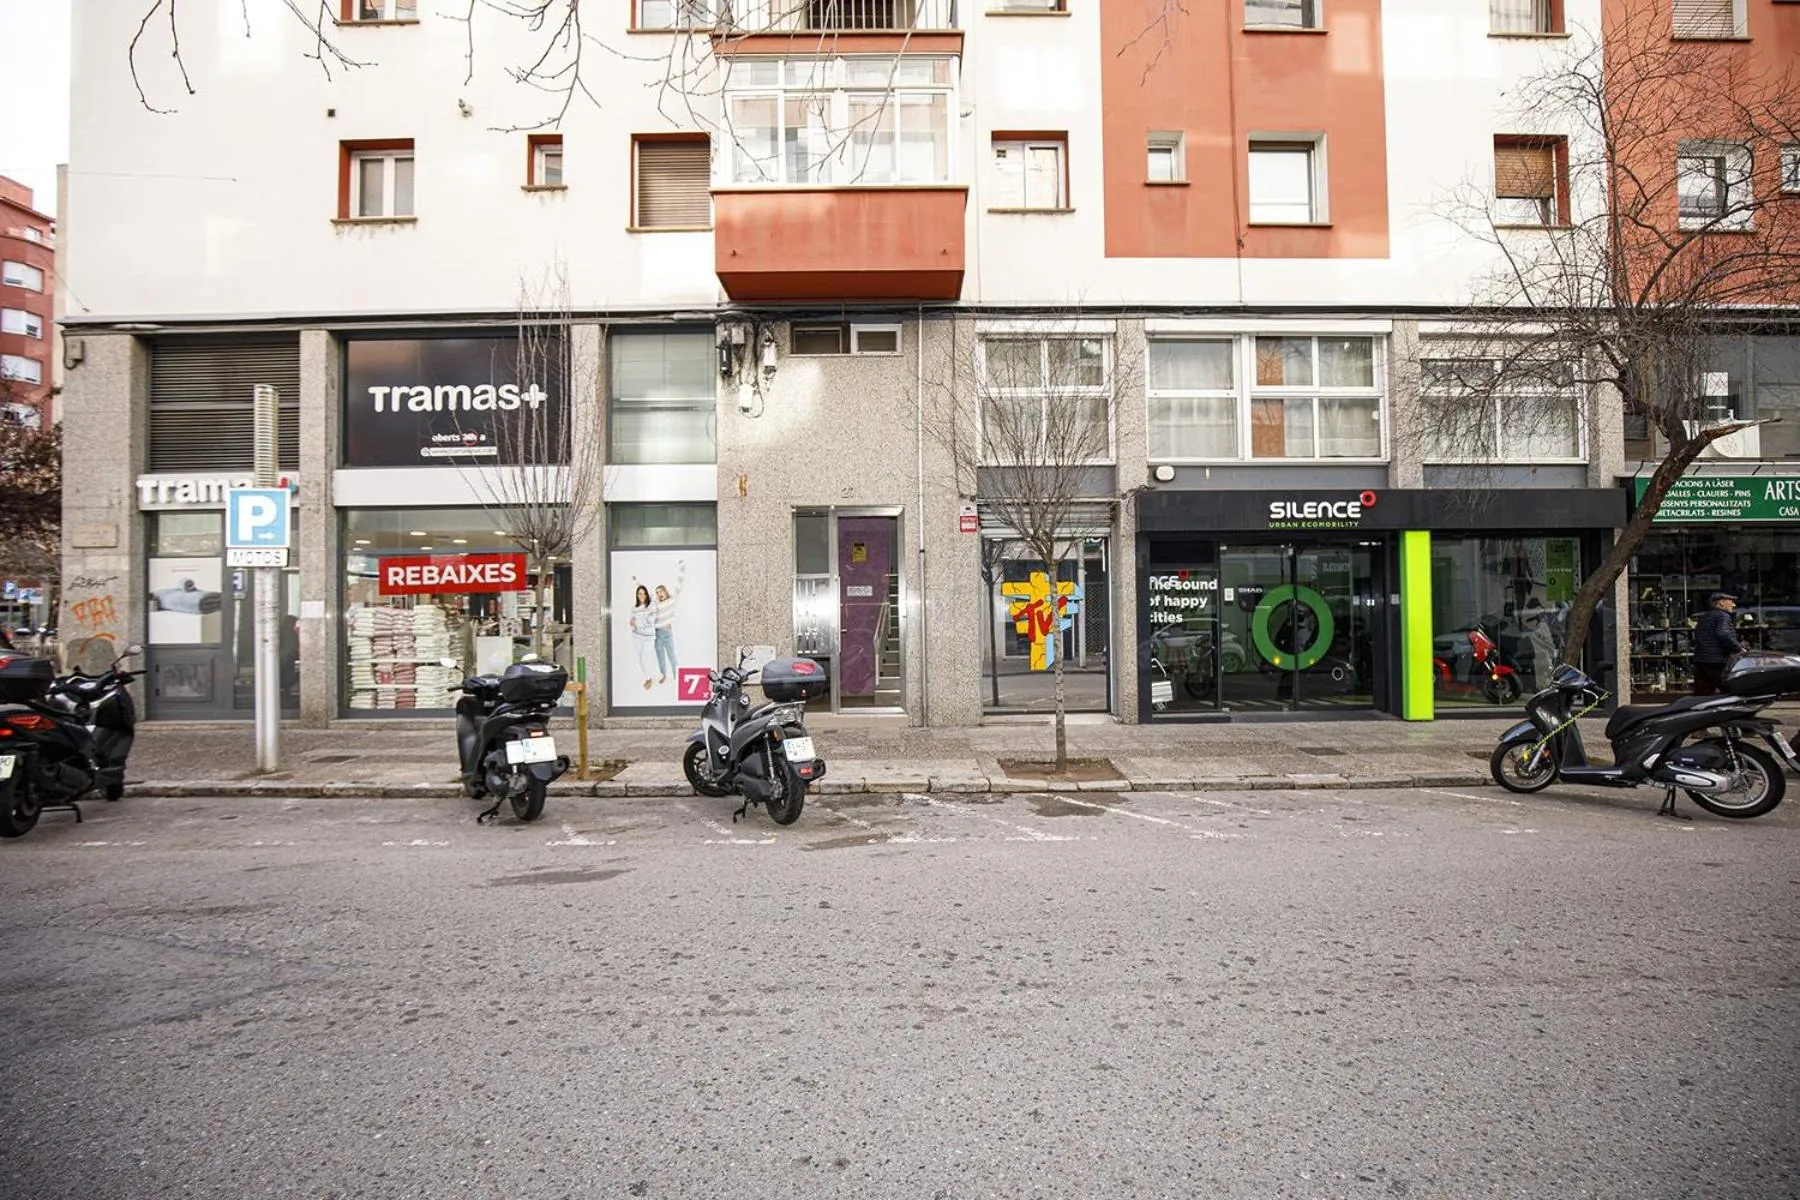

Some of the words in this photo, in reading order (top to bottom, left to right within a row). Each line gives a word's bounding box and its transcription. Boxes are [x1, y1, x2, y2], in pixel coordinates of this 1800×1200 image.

[1673, 480, 1703, 488] ACIONS
[1705, 480, 1711, 488] A
[1696, 490, 1729, 498] CLAUERS
[1735, 490, 1751, 498] PINS
[1270, 501, 1362, 518] SILENCE
[1660, 500, 1689, 508] ISSENYS
[1711, 509, 1741, 517] RESINES
[1778, 506, 1800, 517] CASA
[237, 495, 277, 541] P
[233, 551, 281, 564] MOTOS
[388, 563, 517, 586] REBAIXES
[1164, 594, 1208, 609] happy
